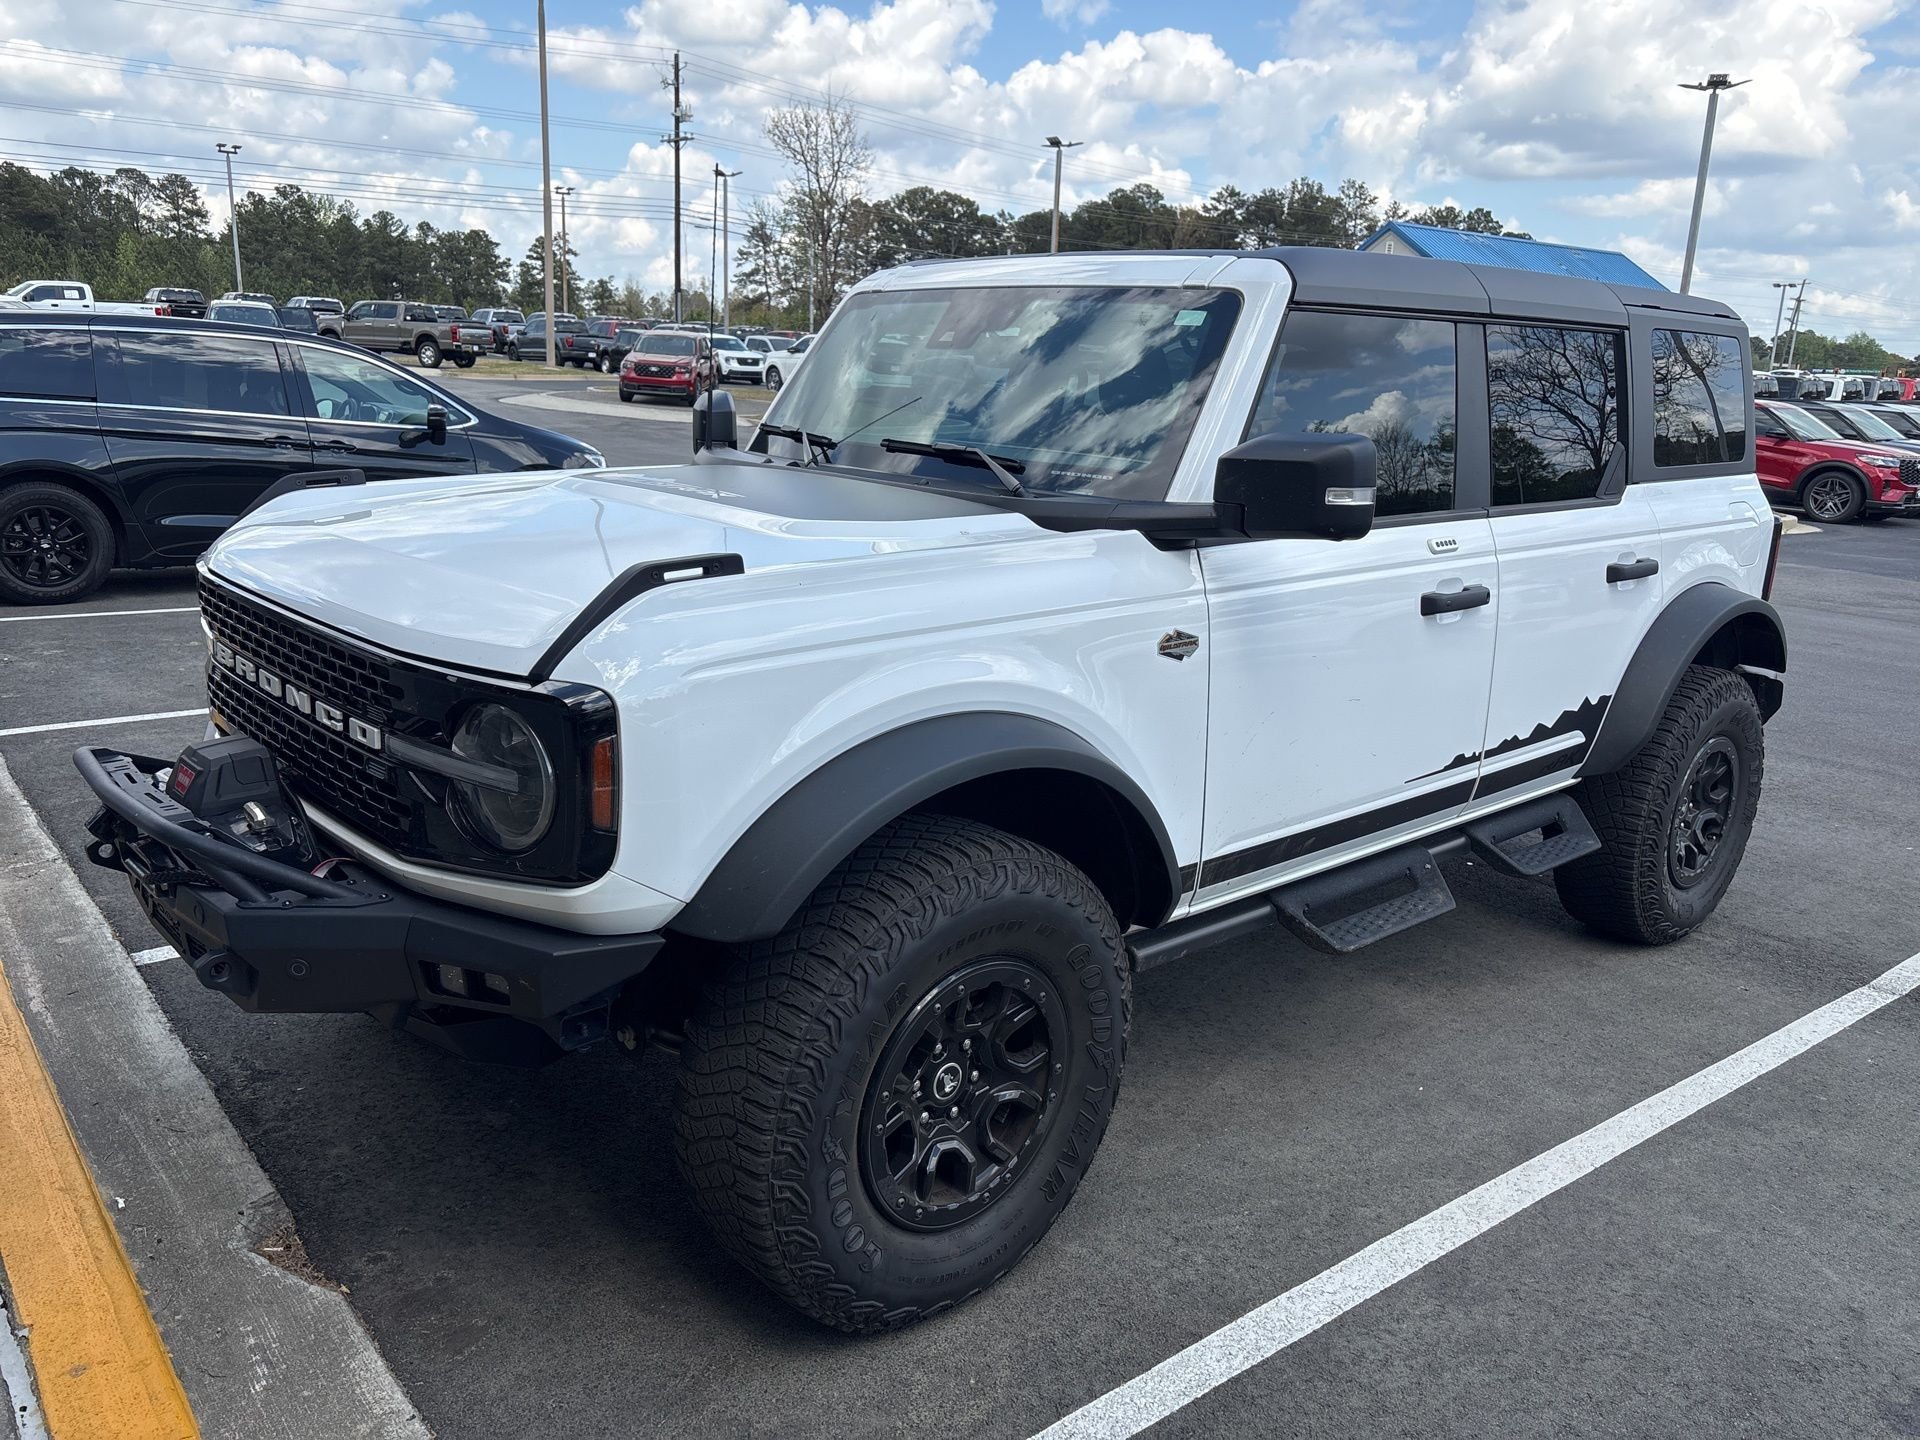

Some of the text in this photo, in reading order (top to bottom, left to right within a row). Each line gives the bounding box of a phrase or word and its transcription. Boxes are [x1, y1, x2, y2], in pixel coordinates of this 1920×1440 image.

[217, 641, 382, 751] BRONCO
[1159, 639, 1198, 652] WILDTRAK
[1040, 943, 1116, 1203] GOODYEAR
